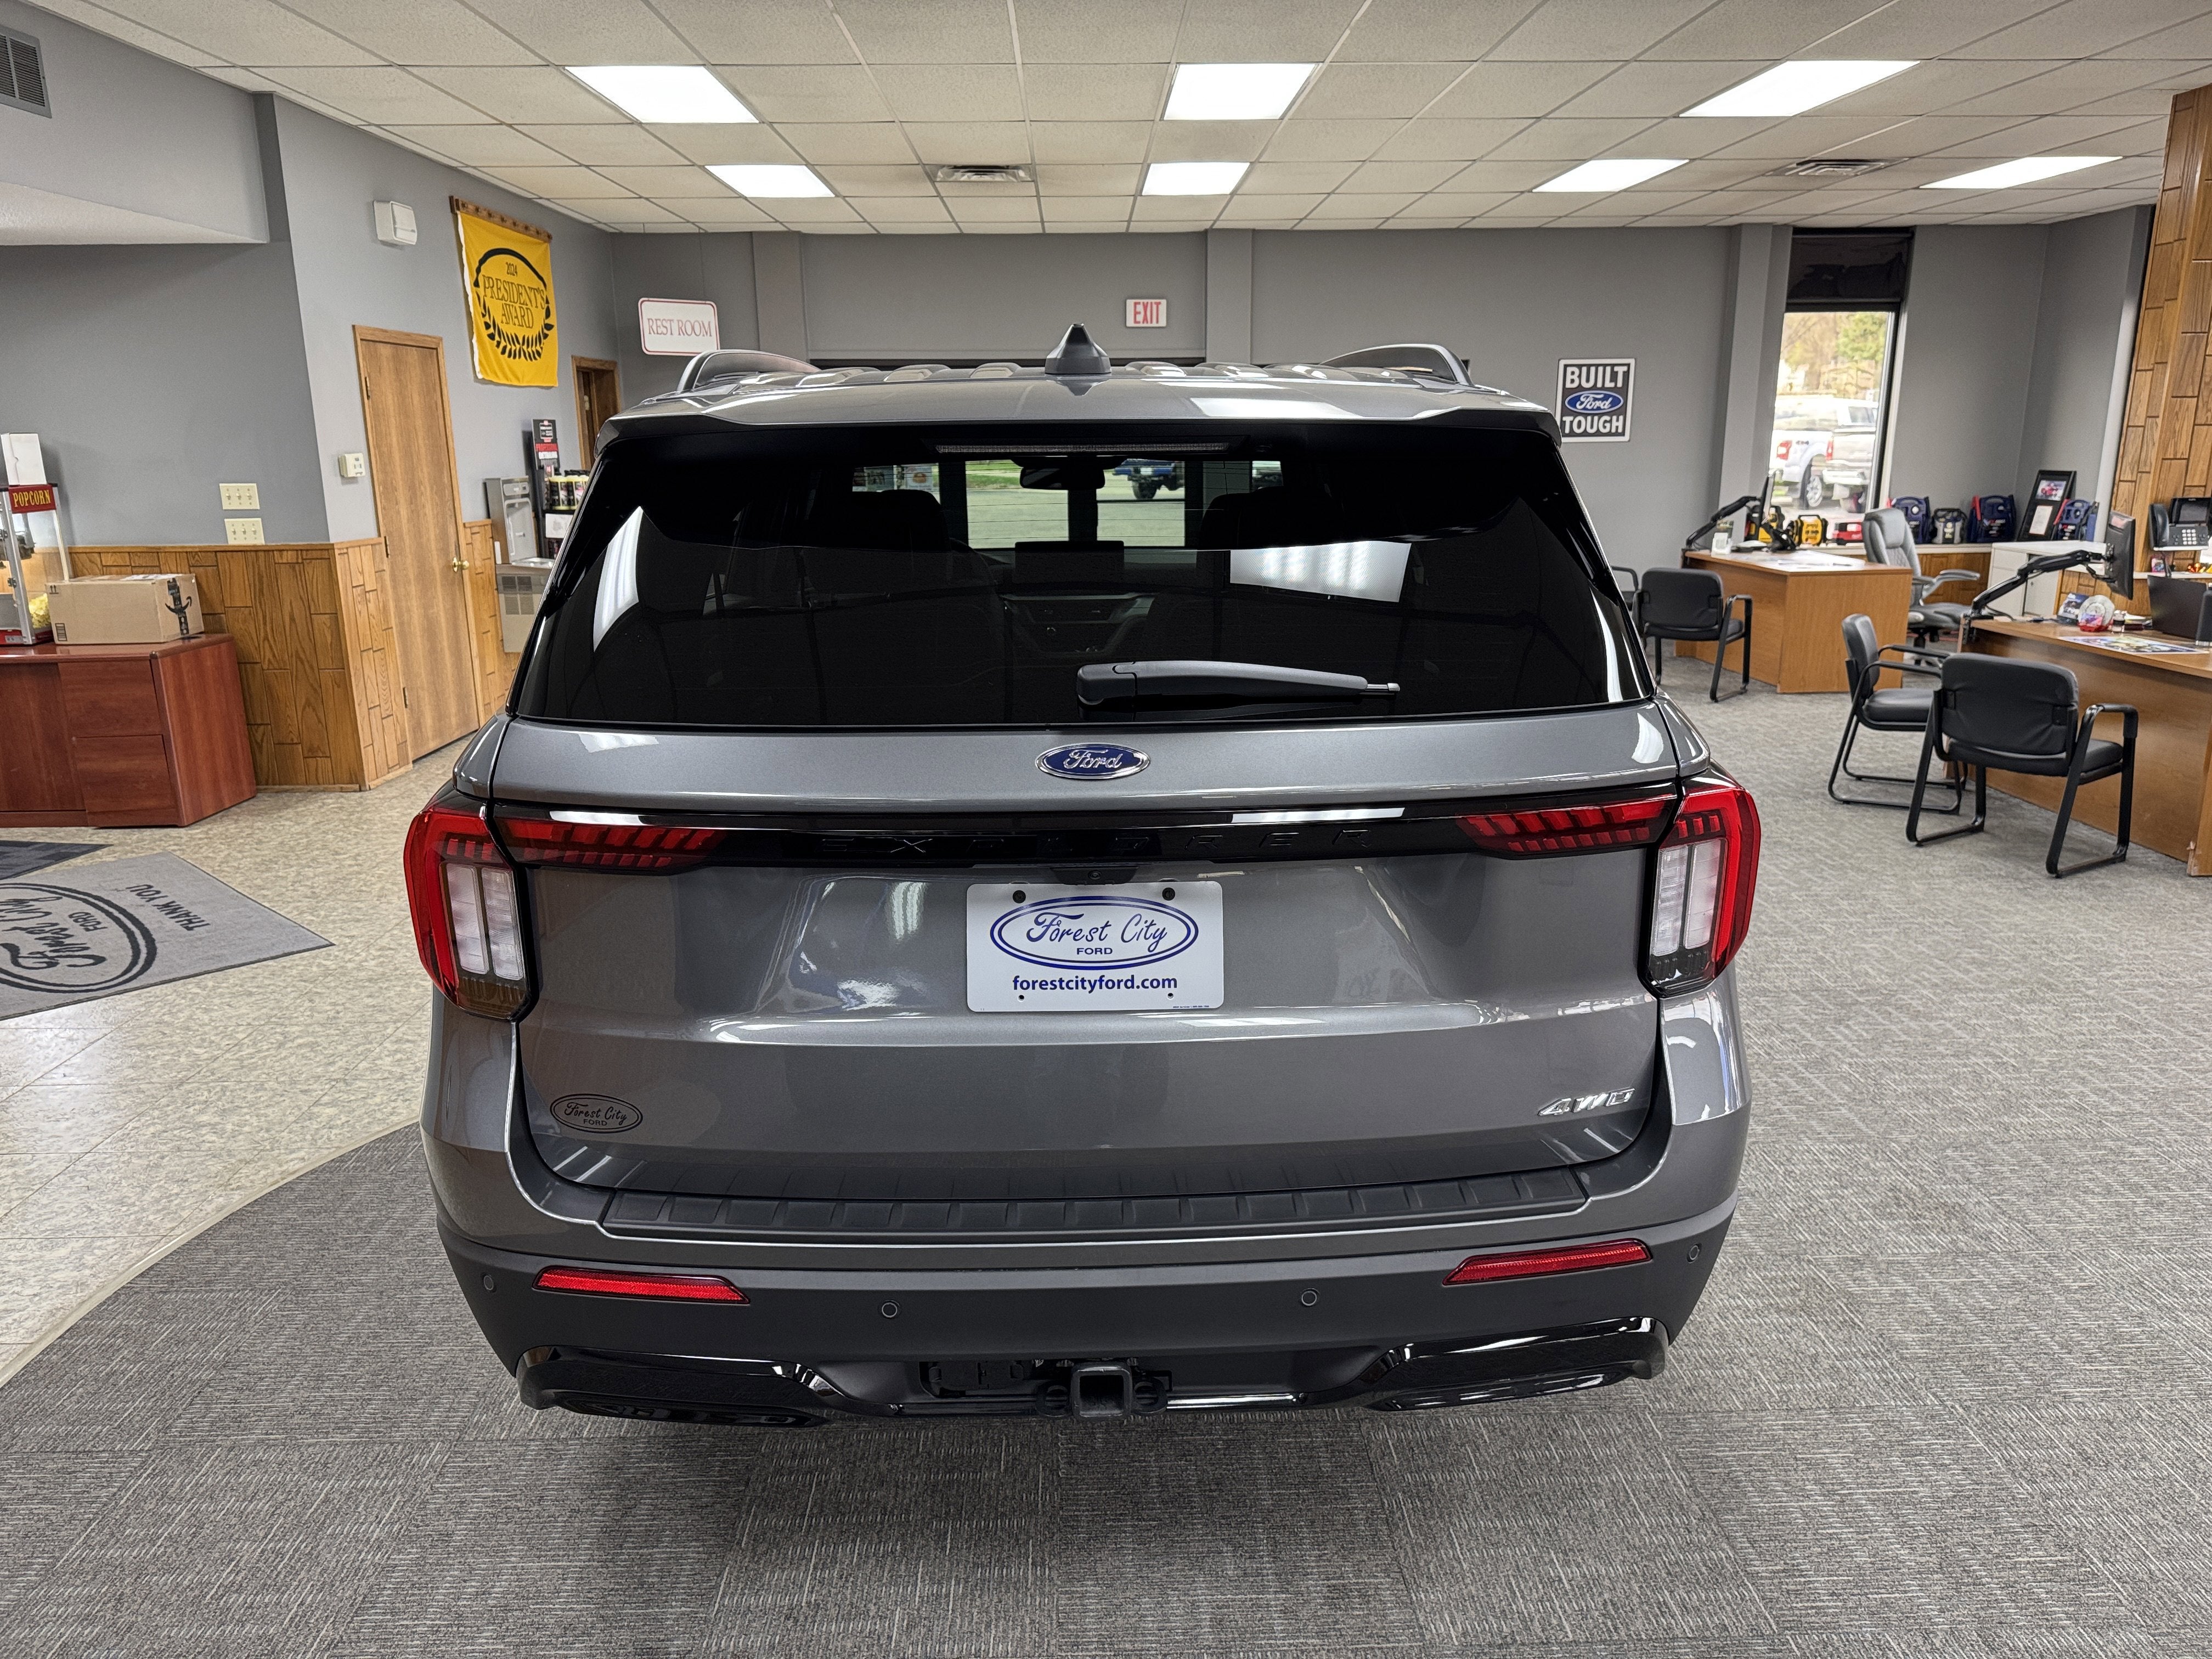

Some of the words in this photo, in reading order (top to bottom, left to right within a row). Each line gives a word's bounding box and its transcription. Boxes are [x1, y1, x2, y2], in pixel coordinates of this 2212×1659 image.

[482, 274, 545, 309] PRESIDENT'S
[500, 303, 534, 329] AWARD
[1133, 302, 1161, 324] EXIT
[647, 318, 674, 335] REST
[676, 319, 712, 337] ROOM
[1565, 366, 1628, 388] BUILT
[1576, 393, 1613, 409] Ford
[1562, 415, 1623, 434] TOUGH
[13, 489, 51, 507] POPCORN
[1063, 749, 1124, 769] Ford
[126, 884, 168, 902] YOU
[68, 911, 108, 932] FORD
[151, 900, 211, 932] THANK
[1026, 911, 1111, 943] Forest
[1120, 913, 1168, 952] City
[1076, 947, 1113, 955] FORD
[1012, 974, 1177, 994] forestcityford.com
[1537, 1087, 1636, 1116] 4WD
[564, 1102, 602, 1119] Forest
[604, 1106, 627, 1125] City
